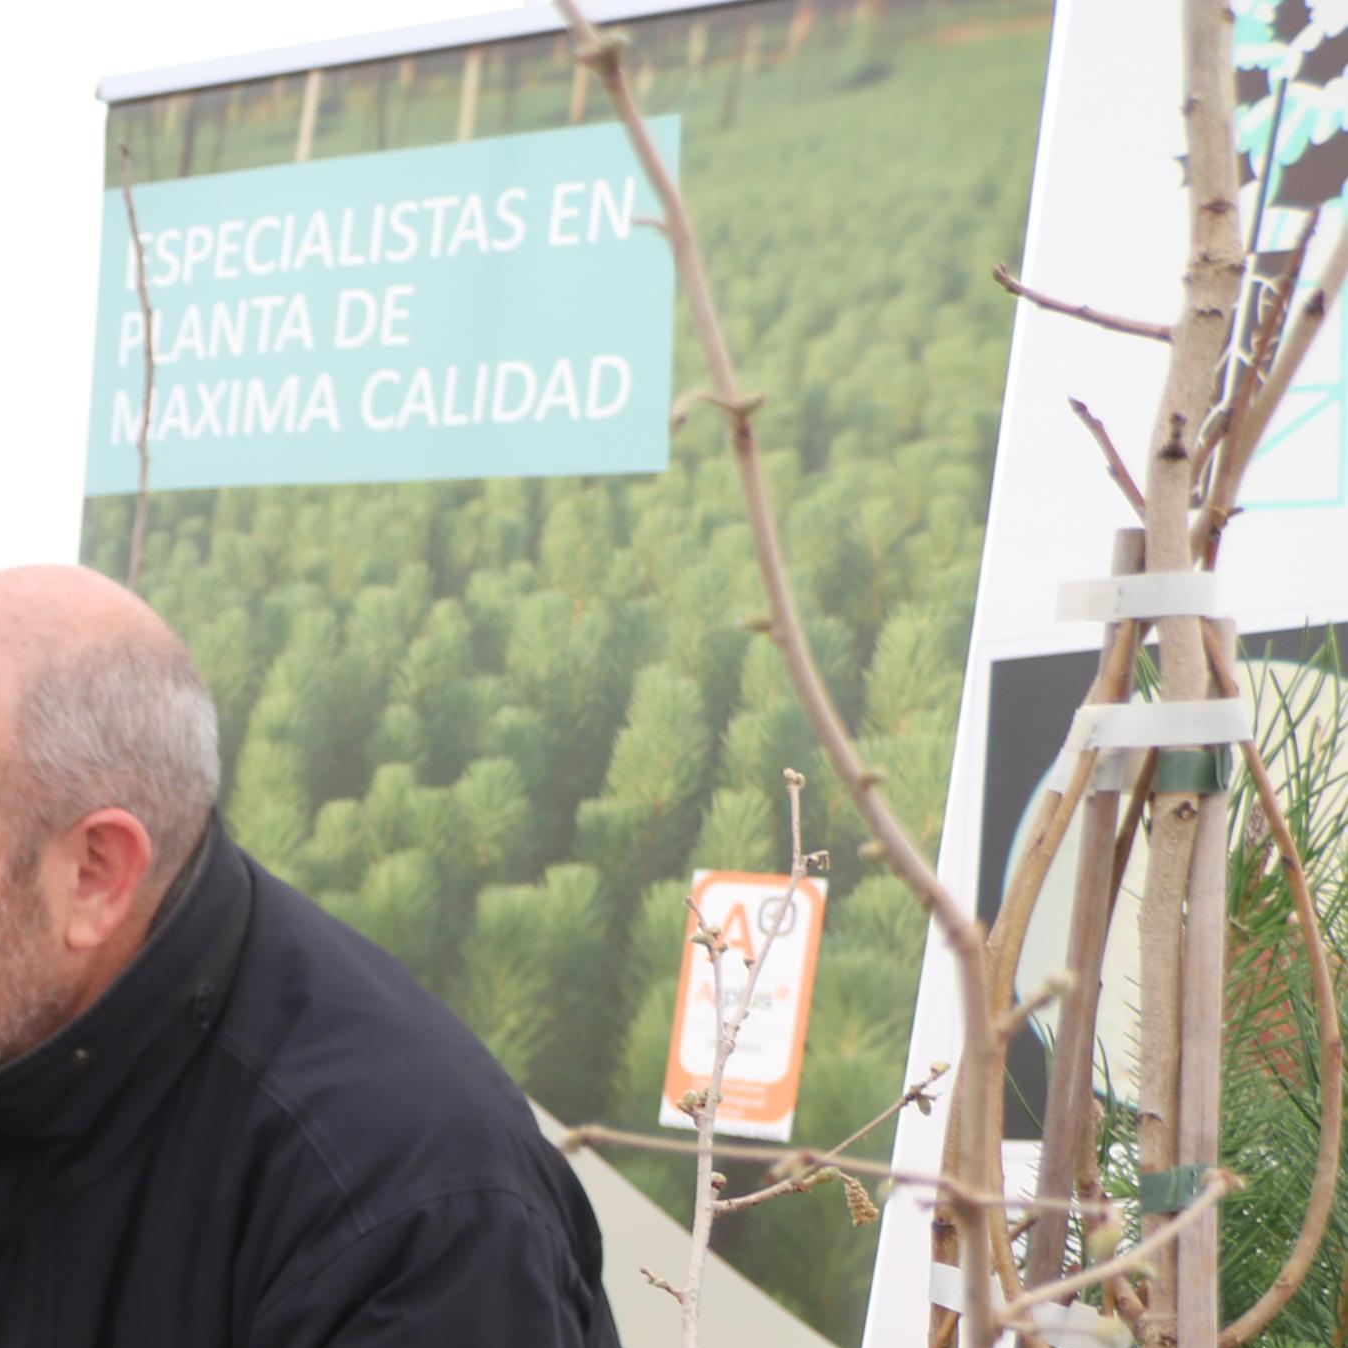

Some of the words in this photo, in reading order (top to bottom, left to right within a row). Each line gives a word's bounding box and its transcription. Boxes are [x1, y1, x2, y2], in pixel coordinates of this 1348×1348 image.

[125, 187, 528, 292] ESPECIALISTAS
[546, 176, 637, 248] EN
[117, 292, 314, 368] PLANTA
[333, 284, 415, 350] DE
[109, 372, 341, 446] MAXIMA
[359, 354, 632, 431] CALIDAD
